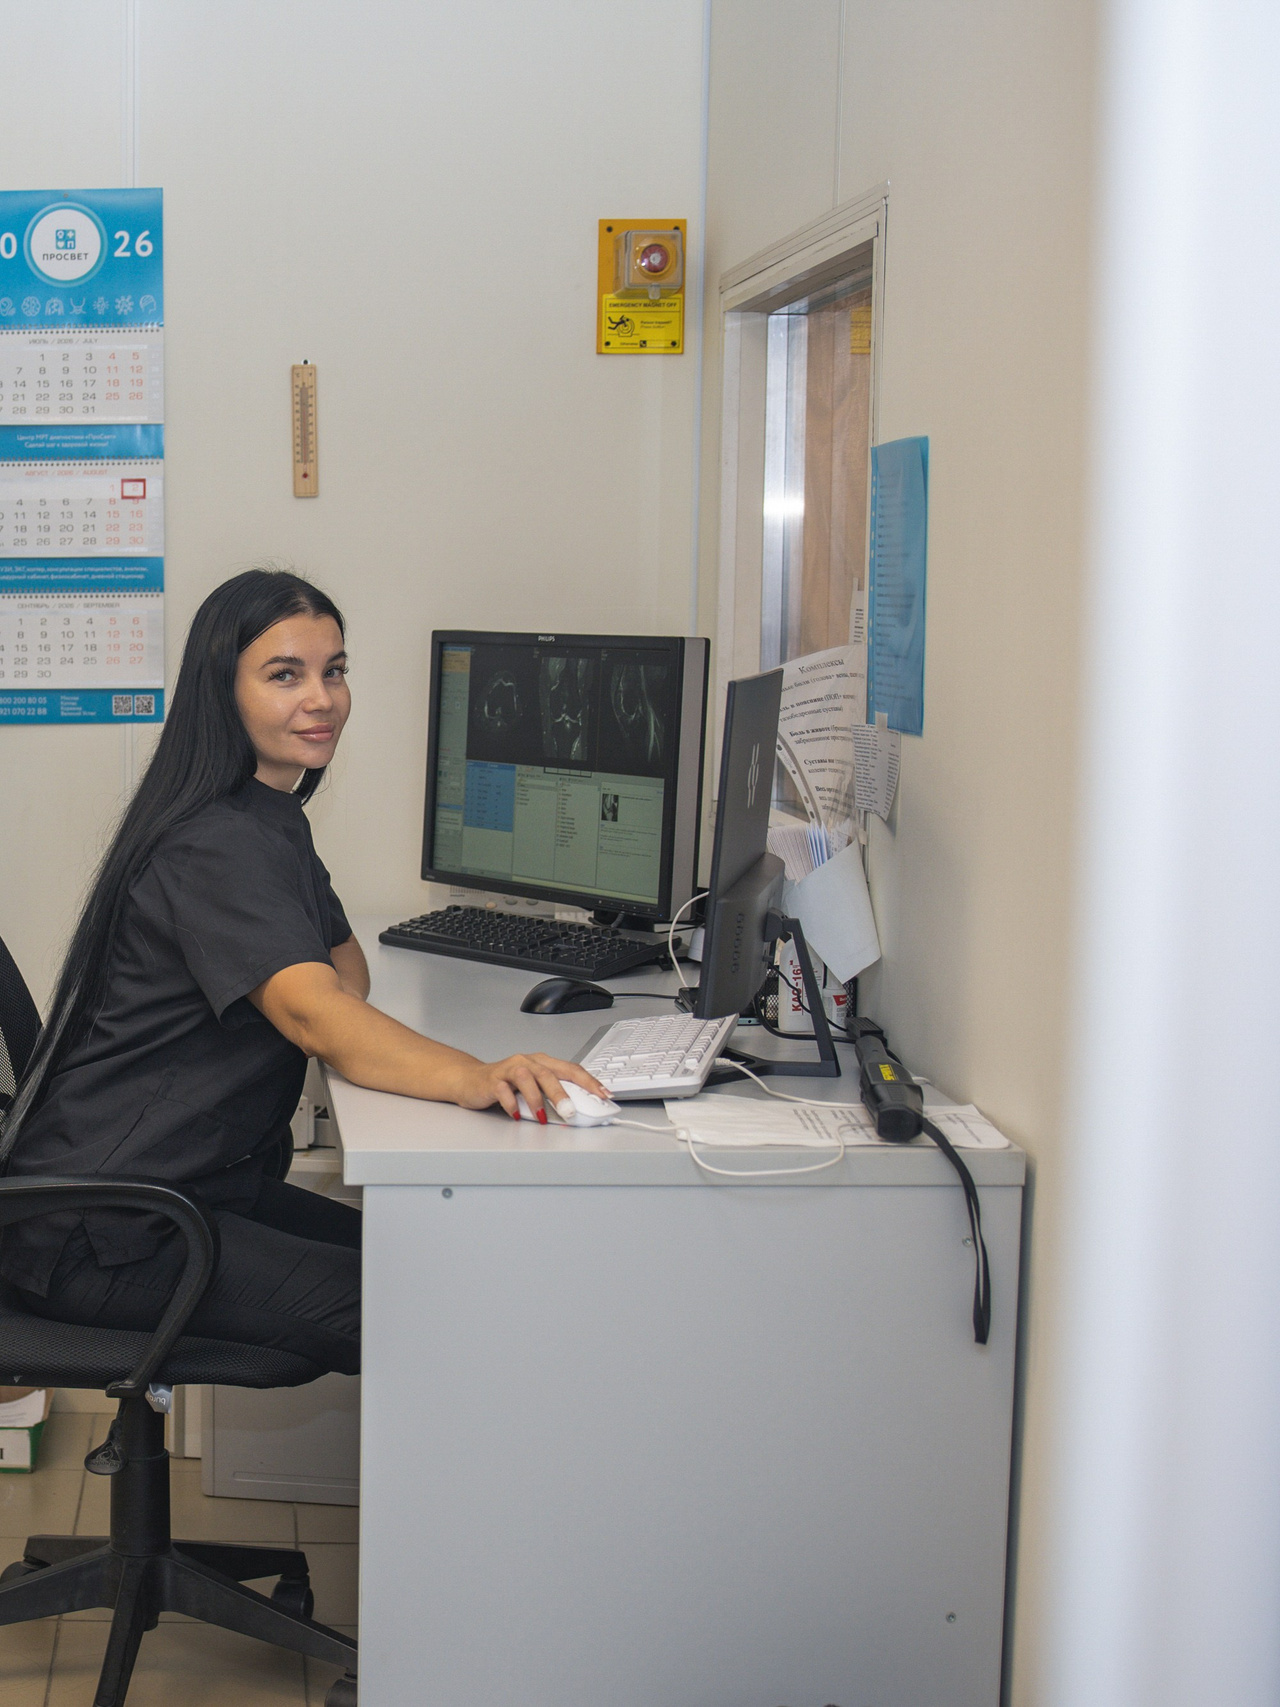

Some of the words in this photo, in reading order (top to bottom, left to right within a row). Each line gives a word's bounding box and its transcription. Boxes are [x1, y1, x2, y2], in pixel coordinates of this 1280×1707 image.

[113, 230, 153, 257] 26
[42, 253, 88, 261] ПРОСВЕТ
[40, 353, 45, 361] 1
[62, 353, 69, 361] 2
[86, 353, 93, 361] 3
[109, 352, 116, 360] 4
[132, 352, 139, 360] 5
[16, 367, 23, 375] 7
[39, 367, 46, 375] 8
[62, 367, 69, 375] 9
[83, 366, 97, 374] 10
[130, 365, 143, 373] 12
[13, 380, 26, 388] 14
[36, 380, 50, 388] 15
[59, 380, 73, 388] 16
[83, 379, 96, 387] 17
[106, 379, 120, 387] 18
[130, 379, 143, 387] 19
[12, 393, 26, 401] 21
[35, 393, 50, 401] 22
[58, 393, 73, 401] 23
[82, 393, 96, 401] 24
[105, 392, 120, 400] 25
[129, 392, 143, 400] 26
[35, 406, 50, 414] 29
[59, 406, 74, 414] 30
[82, 406, 96, 414] 31
[110, 484, 115, 492] 1
[132, 484, 139, 492] 2
[39, 498, 46, 506] 5
[62, 498, 70, 506] 6
[86, 498, 92, 506] 7
[37, 511, 50, 519] 12
[60, 511, 73, 519] 13
[83, 511, 97, 519] 14
[130, 510, 143, 518] 16
[14, 525, 27, 533] 18
[37, 525, 50, 533] 19
[59, 524, 74, 532] 20
[82, 524, 96, 532] 21
[105, 524, 120, 532] 22
[13, 538, 27, 546] 25
[36, 538, 51, 546] 26
[59, 538, 74, 546] 27
[82, 537, 97, 545] 28
[106, 537, 120, 545] 29
[129, 537, 143, 545] 30
[18, 618, 23, 626] 1
[86, 617, 93, 625] 4
[109, 617, 116, 625] 5
[132, 617, 140, 625] 6
[17, 631, 24, 639] 8
[40, 631, 47, 639] 9
[107, 630, 120, 638] 12
[130, 630, 143, 638] 13
[14, 644, 28, 652] 15
[37, 644, 51, 652] 16
[60, 644, 74, 652] 17
[129, 643, 144, 651] 20
[14, 657, 28, 665] 22
[37, 657, 51, 665] 23
[60, 657, 74, 665] 24
[83, 657, 97, 665] 25
[106, 657, 120, 665] 26
[129, 656, 143, 664] 27
[798, 659, 844, 674] Комплексы
[14, 670, 28, 678] 29
[37, 670, 52, 678] 30
[803, 758, 827, 766] Суставы
